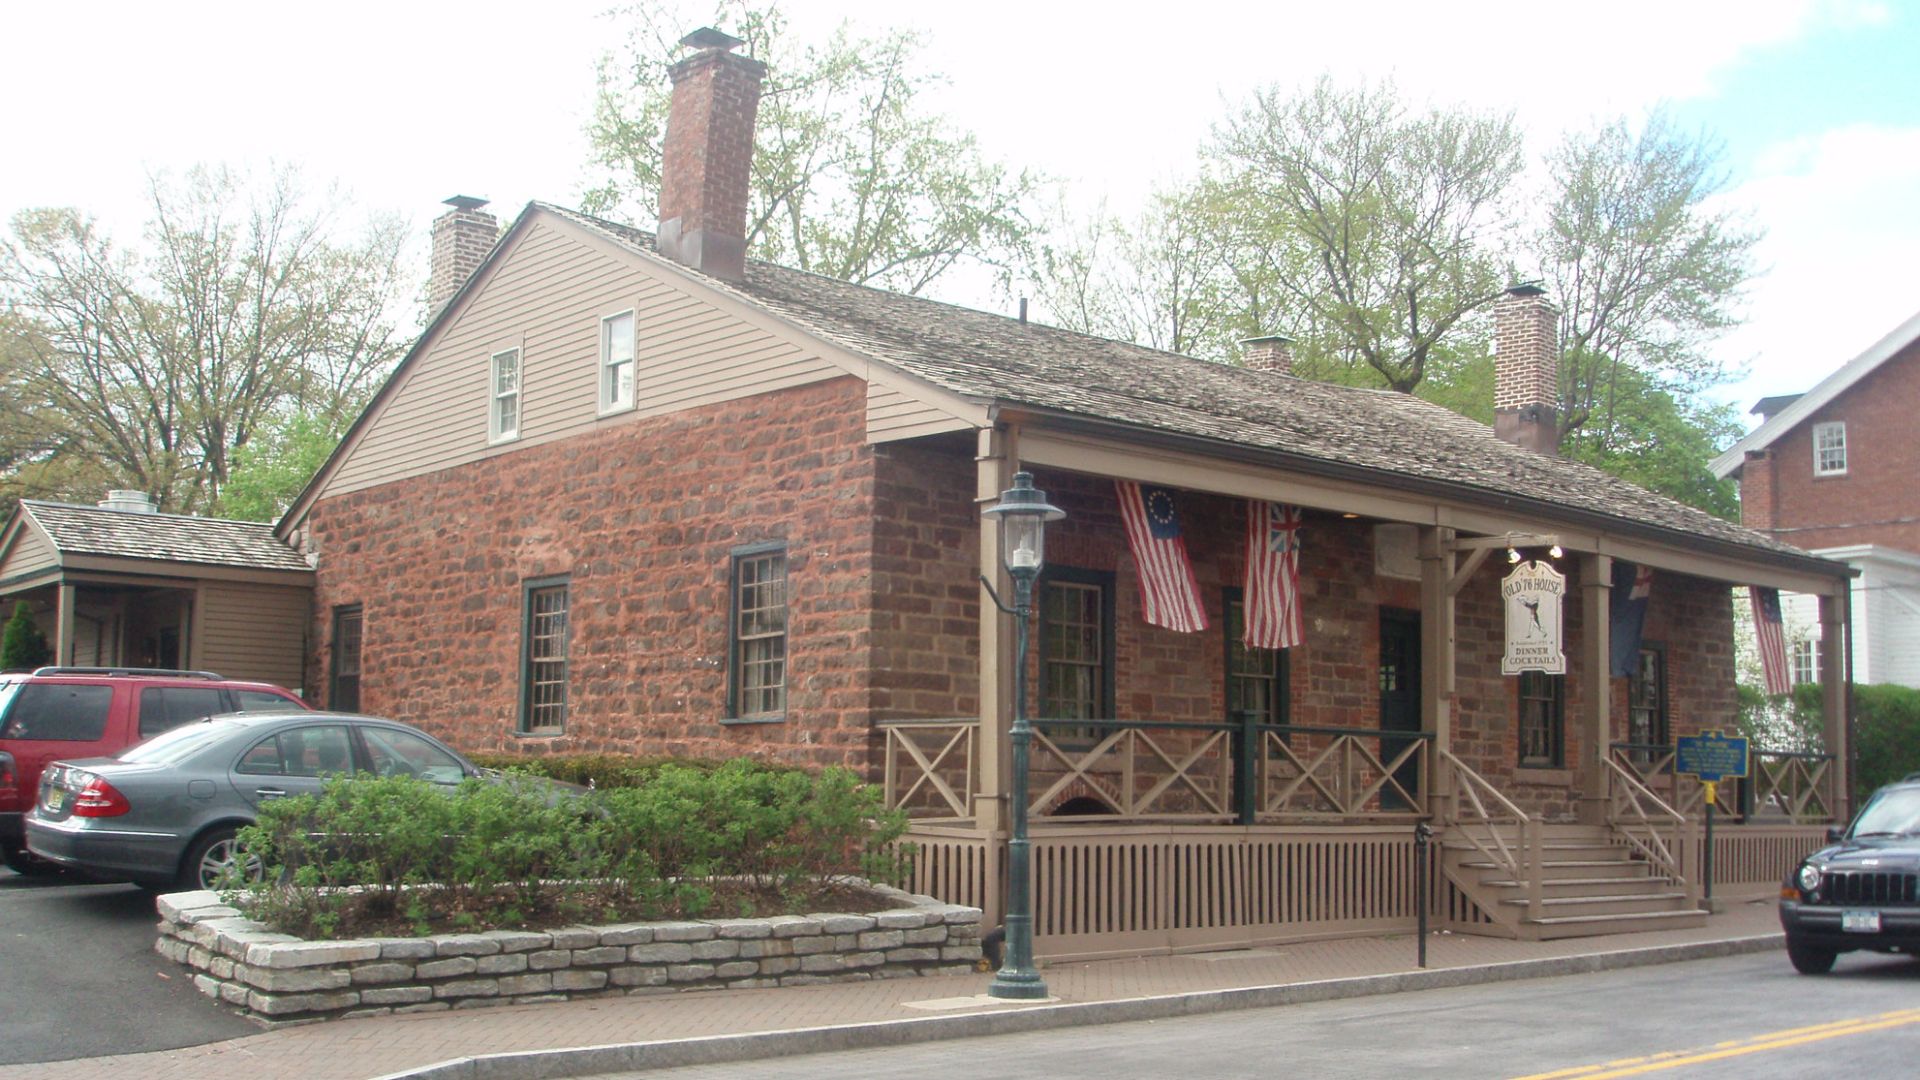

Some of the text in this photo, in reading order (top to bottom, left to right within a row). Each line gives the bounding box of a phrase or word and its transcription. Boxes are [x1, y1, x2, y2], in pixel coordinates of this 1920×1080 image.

[1505, 581, 1521, 596] OLD
[1534, 578, 1560, 595] HOUSE
[1515, 647, 1548, 655] DINNER
[1510, 656, 1556, 664] COCKTAILS
